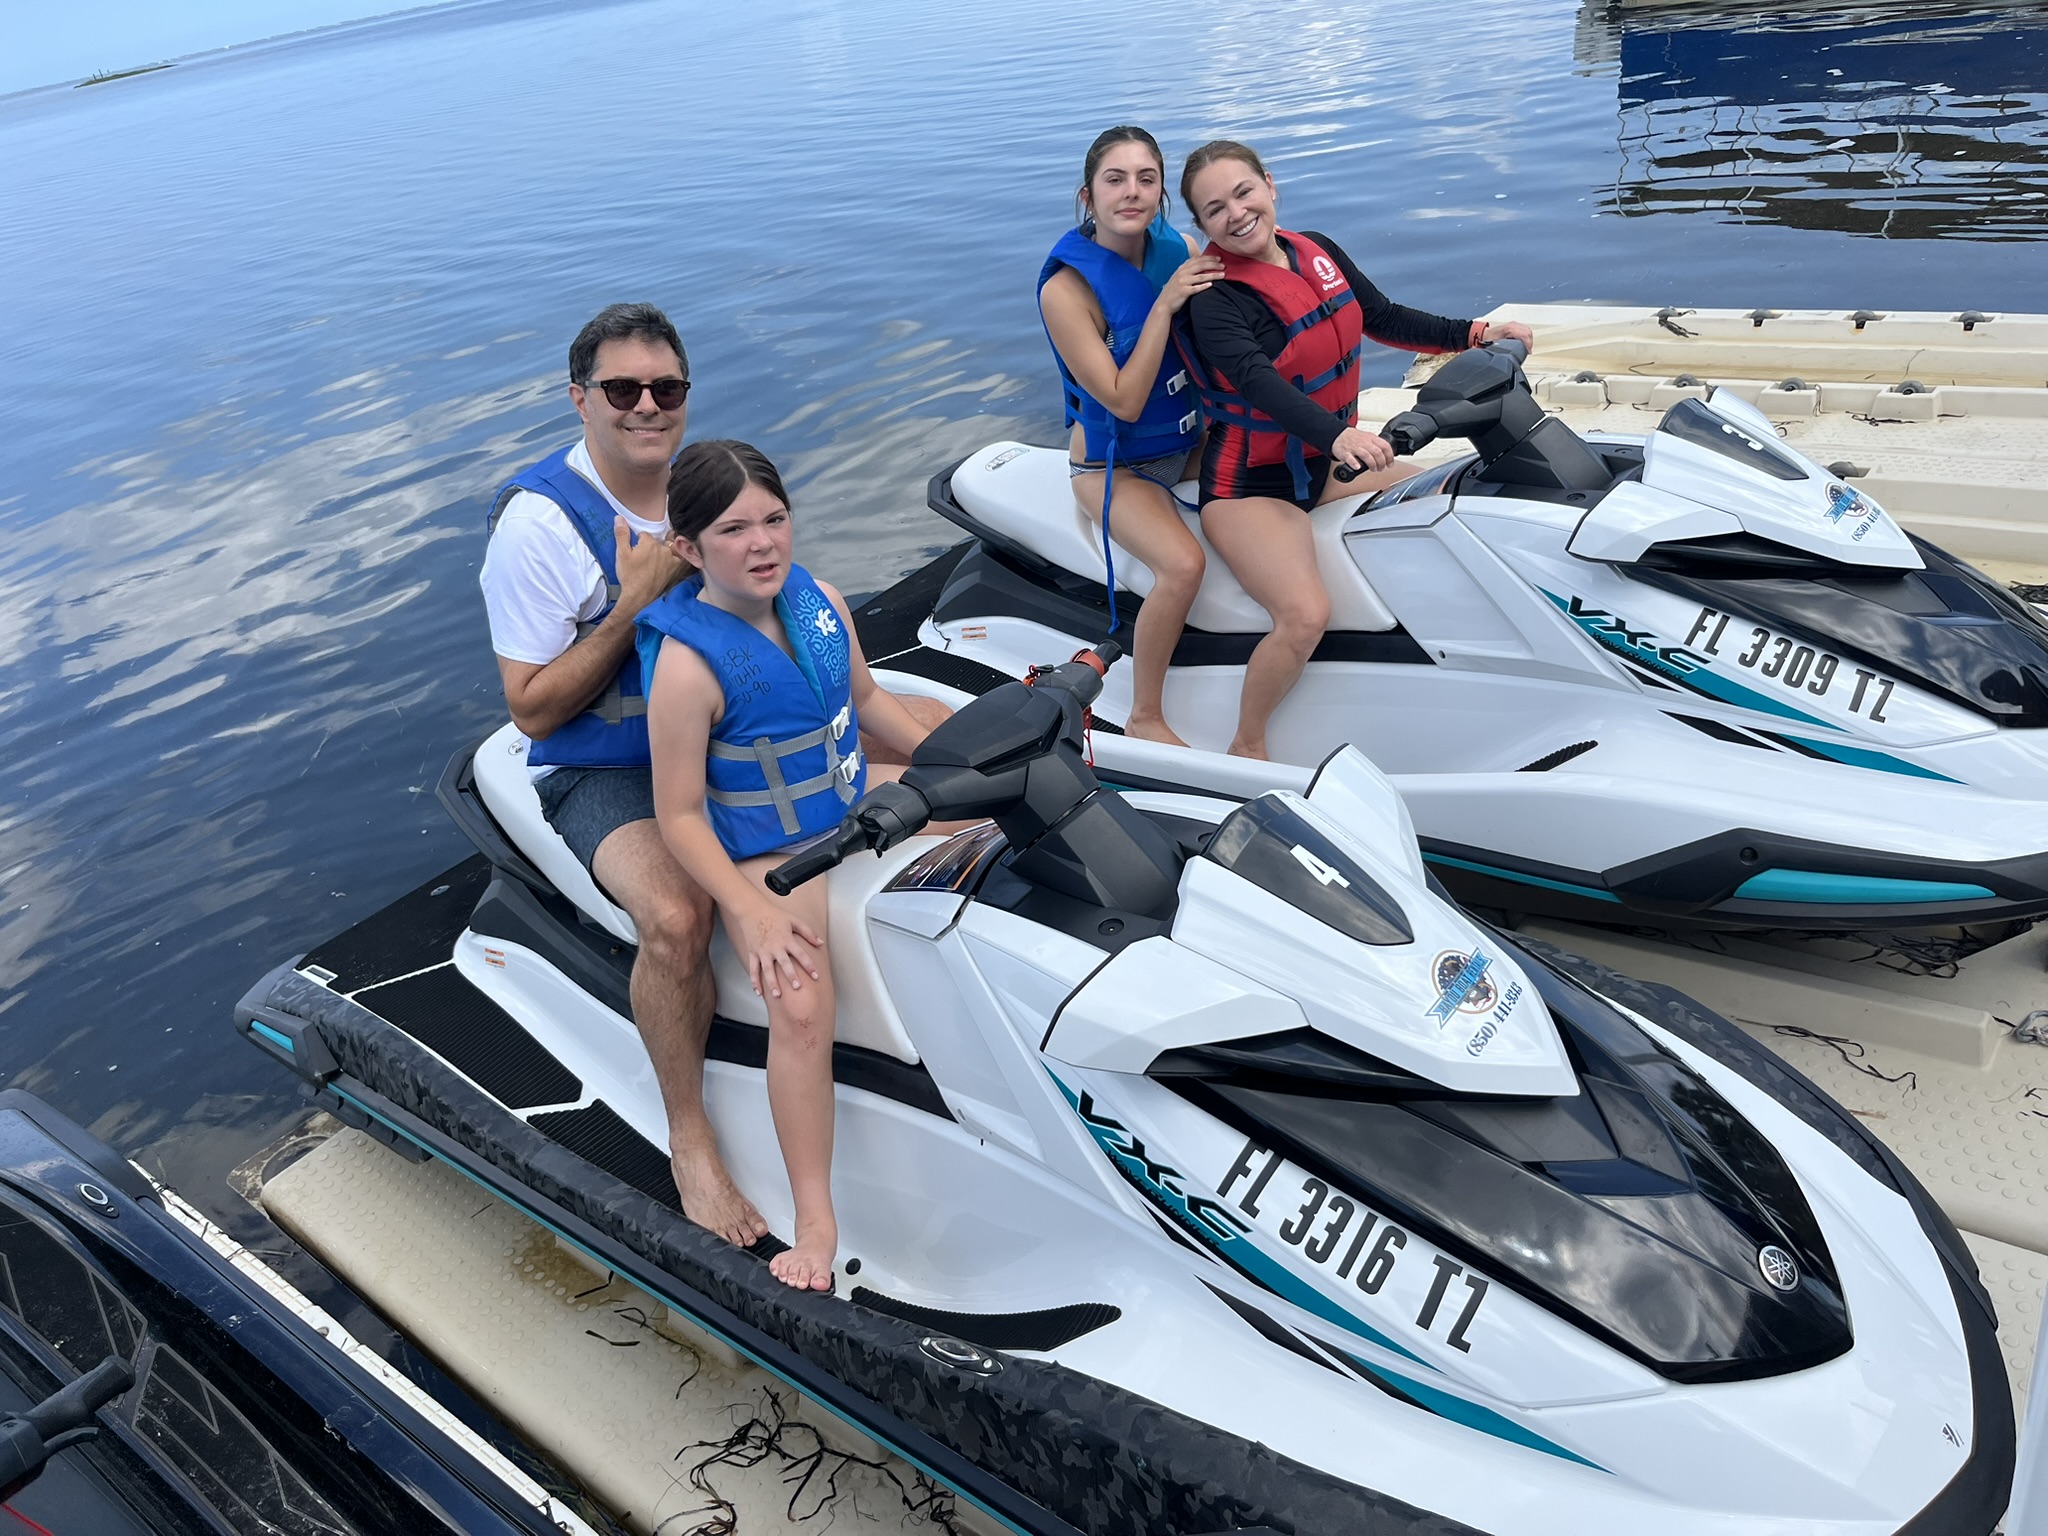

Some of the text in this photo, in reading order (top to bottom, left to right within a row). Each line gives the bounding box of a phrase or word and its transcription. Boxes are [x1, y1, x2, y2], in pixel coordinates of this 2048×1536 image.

[1721, 424, 1764, 451] 3
[1683, 606, 1895, 724] FL 3309 TZ
[1290, 844, 1351, 889] 4
[1440, 990, 1460, 1014] BAYOU
[1456, 974, 1473, 992] BOAT
[1466, 1022, 1497, 1056] (850)
[1216, 1138, 1490, 1355] FL 3316 TZ
